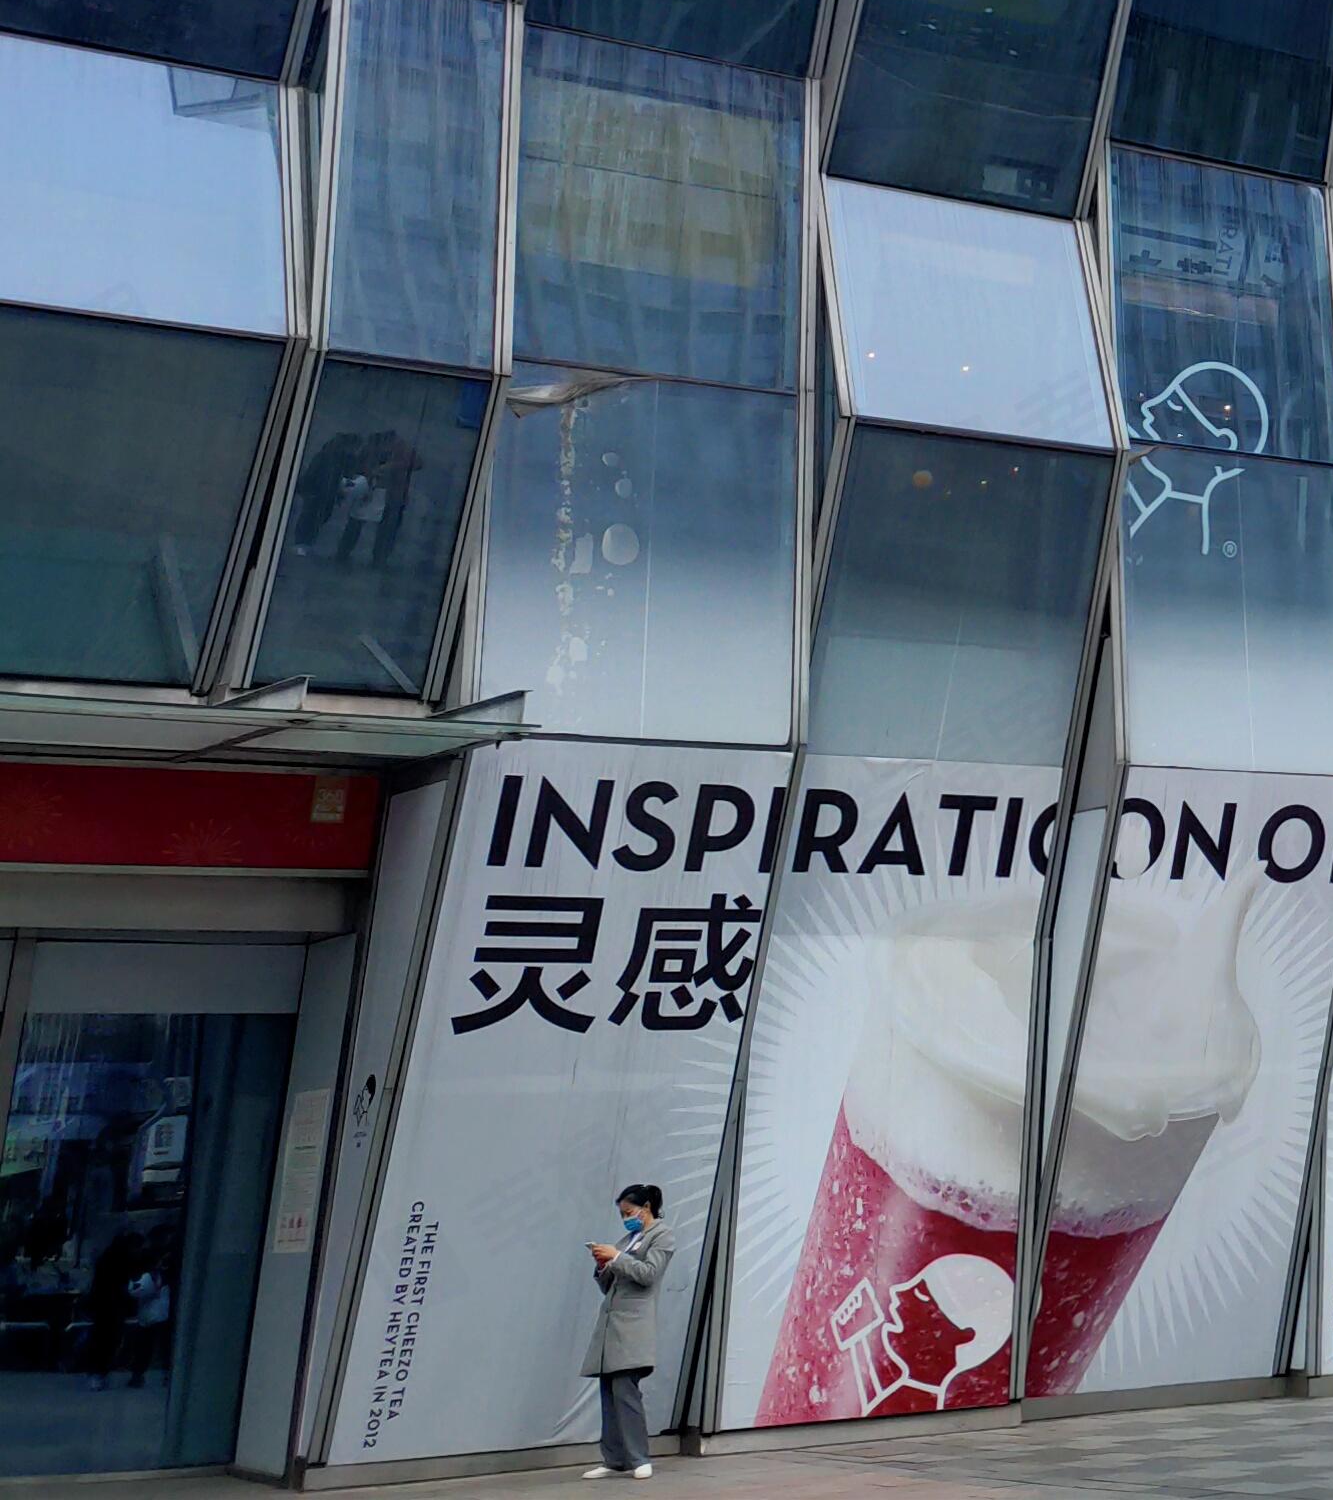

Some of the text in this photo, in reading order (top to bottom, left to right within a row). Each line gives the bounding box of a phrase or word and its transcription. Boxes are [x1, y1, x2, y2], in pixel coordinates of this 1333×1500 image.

[451, 893, 763, 1035] 灵感
[362, 1201, 425, 1449] CREATED BY HEYTEA IN 2012
[385, 1221, 439, 1422] THE FIRST CHEEZO TEA
